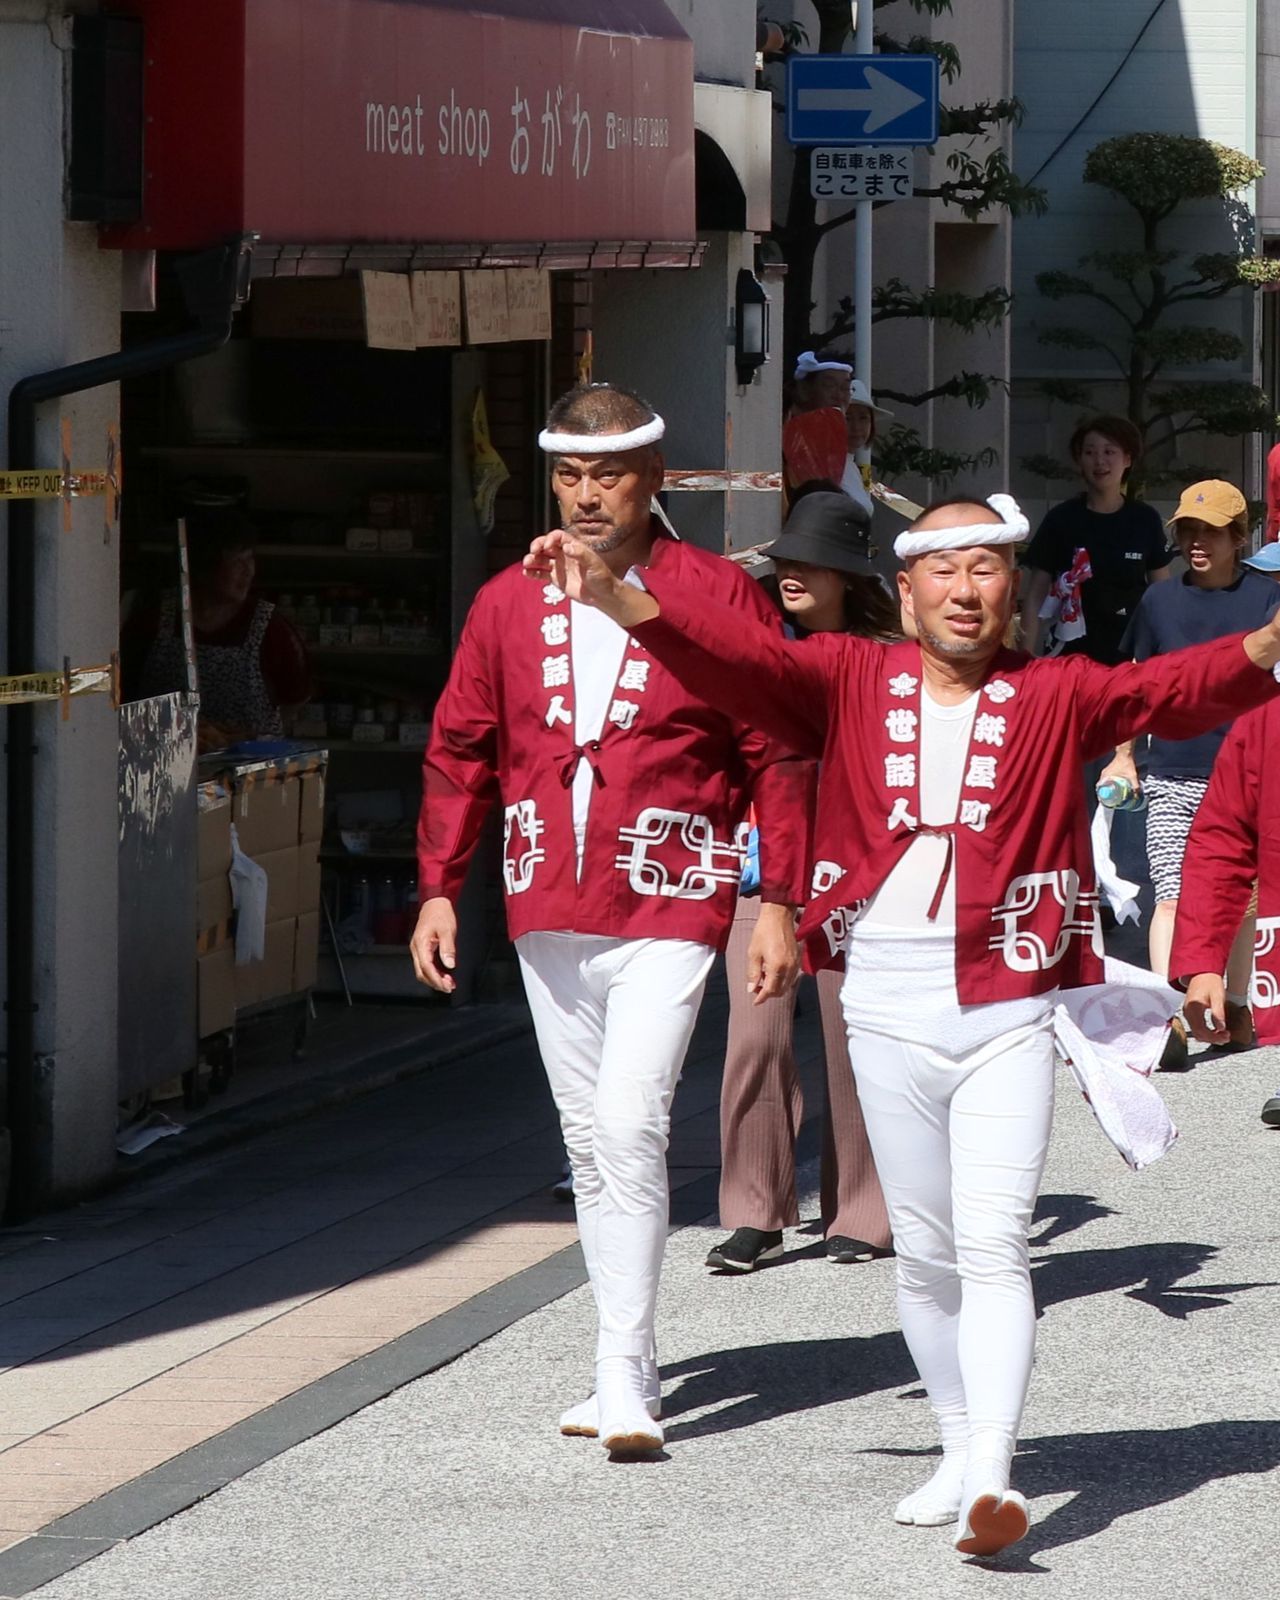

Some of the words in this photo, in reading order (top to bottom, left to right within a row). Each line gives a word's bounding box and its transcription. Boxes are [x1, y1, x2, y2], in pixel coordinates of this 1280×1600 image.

[366, 94, 424, 155] meat
[438, 87, 490, 167] shop
[510, 86, 592, 180] おがわ
[816, 153, 907, 169] 自転車を除く
[815, 174, 910, 195] ここまで
[43, 475, 61, 493] OUT
[540, 613, 573, 727] 世話人
[608, 637, 651, 730] 屋町
[884, 708, 919, 831] 世話人
[960, 711, 1007, 832] 紙屋町
